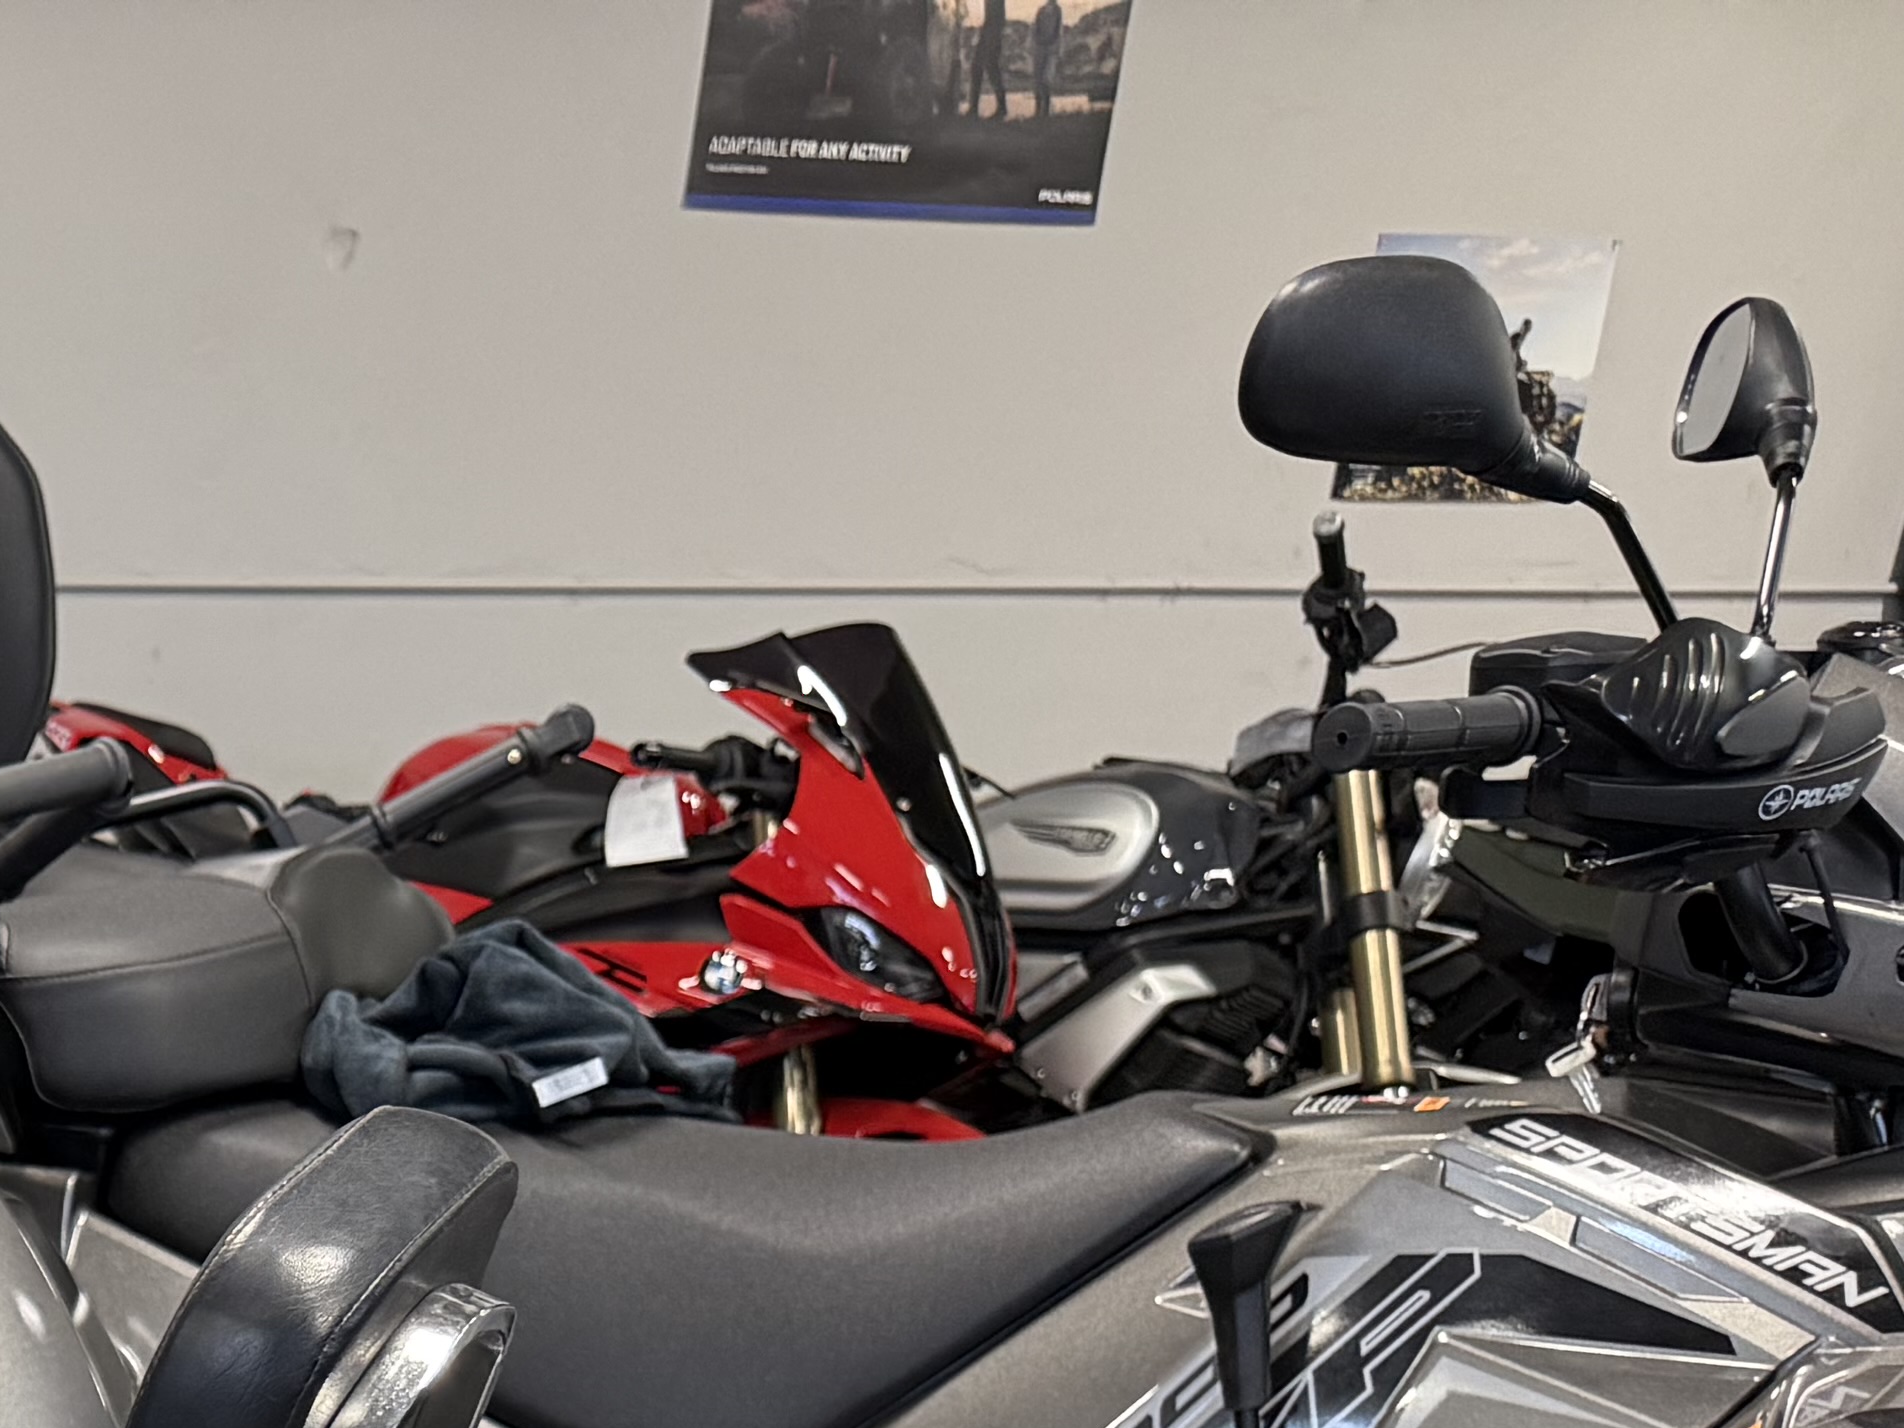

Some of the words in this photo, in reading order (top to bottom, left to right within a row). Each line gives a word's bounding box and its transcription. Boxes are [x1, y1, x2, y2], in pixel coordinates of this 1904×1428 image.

[709, 135, 790, 158] ADAPTABLE
[790, 139, 818, 159] FOR
[818, 139, 849, 160] ANY
[848, 141, 912, 164] ACTIVITY
[1790, 776, 1863, 811] POLARIS
